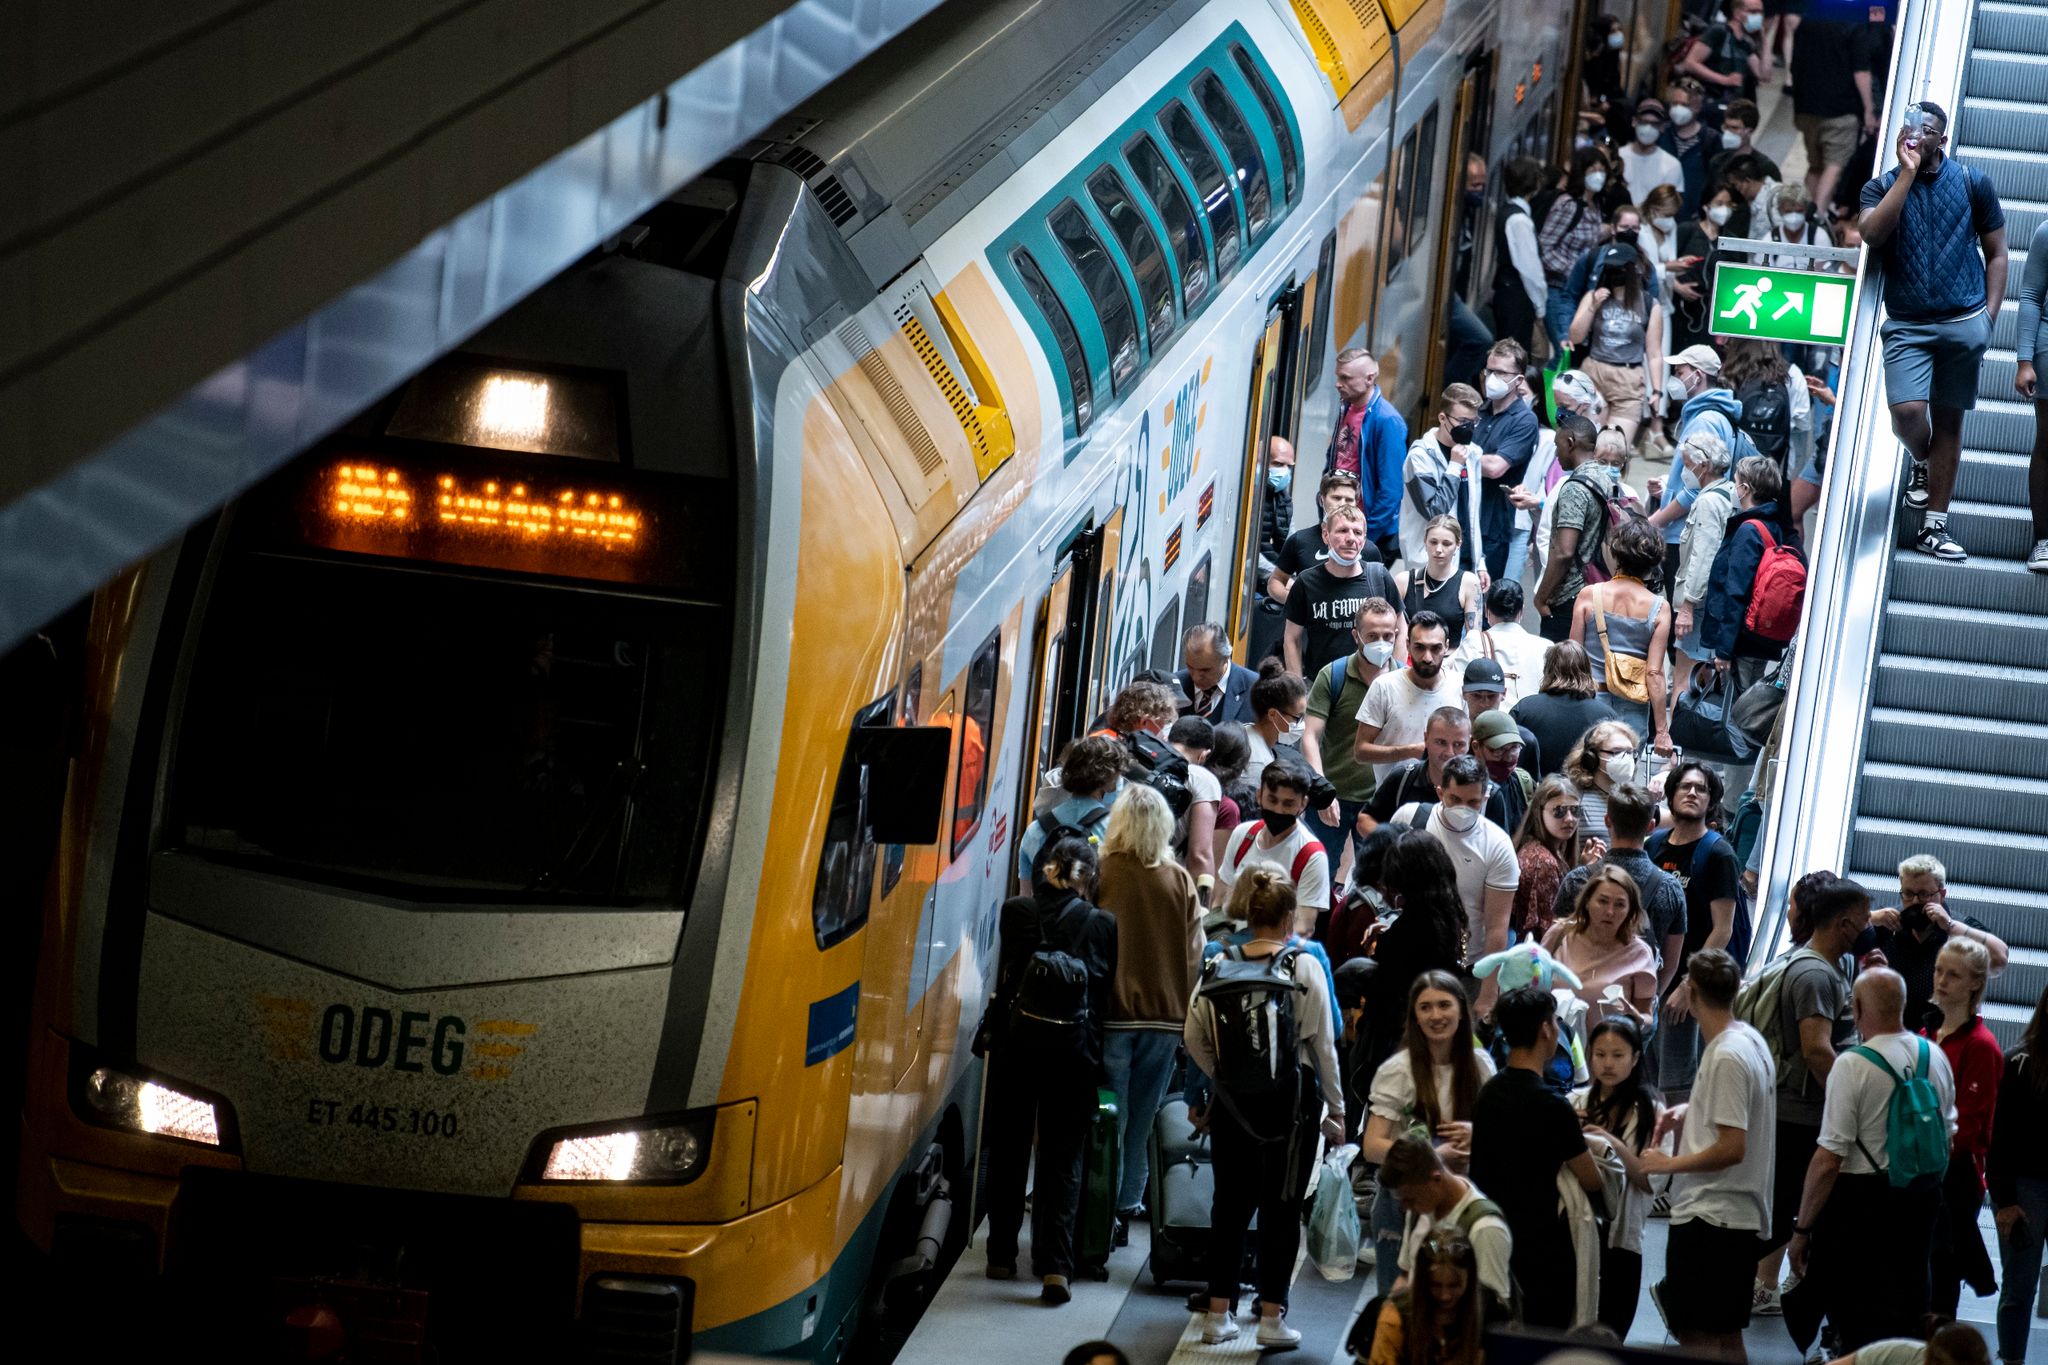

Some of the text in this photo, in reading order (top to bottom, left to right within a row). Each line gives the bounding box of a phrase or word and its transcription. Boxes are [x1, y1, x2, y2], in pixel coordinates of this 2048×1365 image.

[1166, 368, 1200, 507] ODEG
[1750, 422, 1773, 431] AIR
[1312, 601, 1328, 620] LA
[318, 1003, 467, 1077] ODEG
[307, 1099, 457, 1138] ET 445.100
